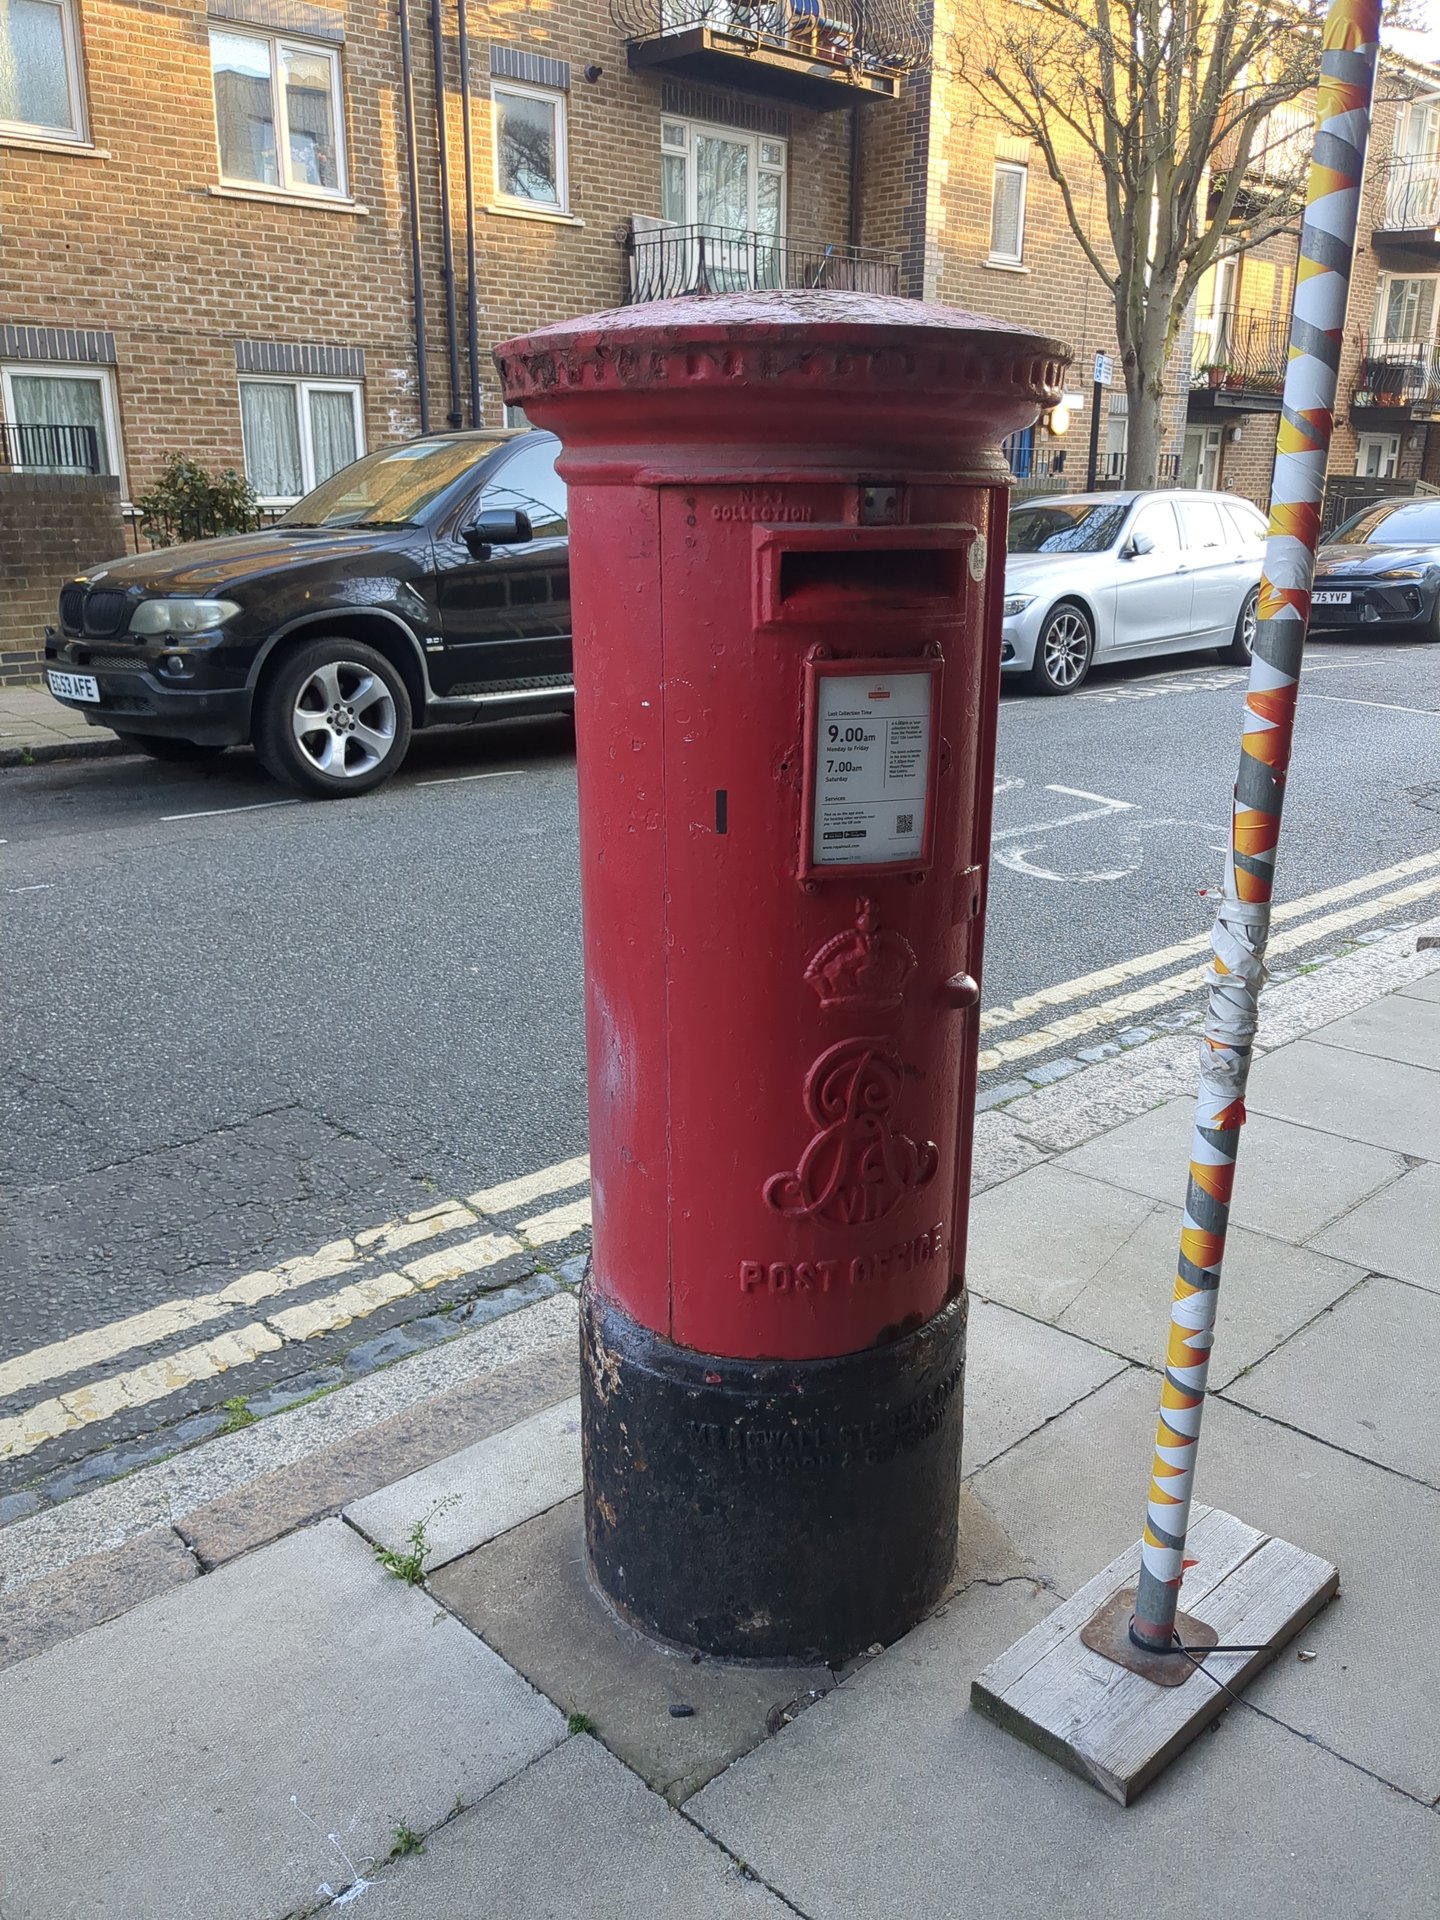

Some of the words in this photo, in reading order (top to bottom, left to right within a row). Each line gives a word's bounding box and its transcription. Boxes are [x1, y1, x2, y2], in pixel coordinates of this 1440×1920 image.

[712, 504, 812, 522] COLLECTION
[1329, 592, 1347, 602] YVP
[50, 672, 73, 695] EG53
[73, 676, 94, 698] AFE
[828, 724, 876, 743] 9.00am
[853, 744, 869, 752] Friday
[826, 760, 862, 773] 7.00am
[738, 1259, 840, 1294] POST
[851, 1221, 944, 1284] OFFICE
